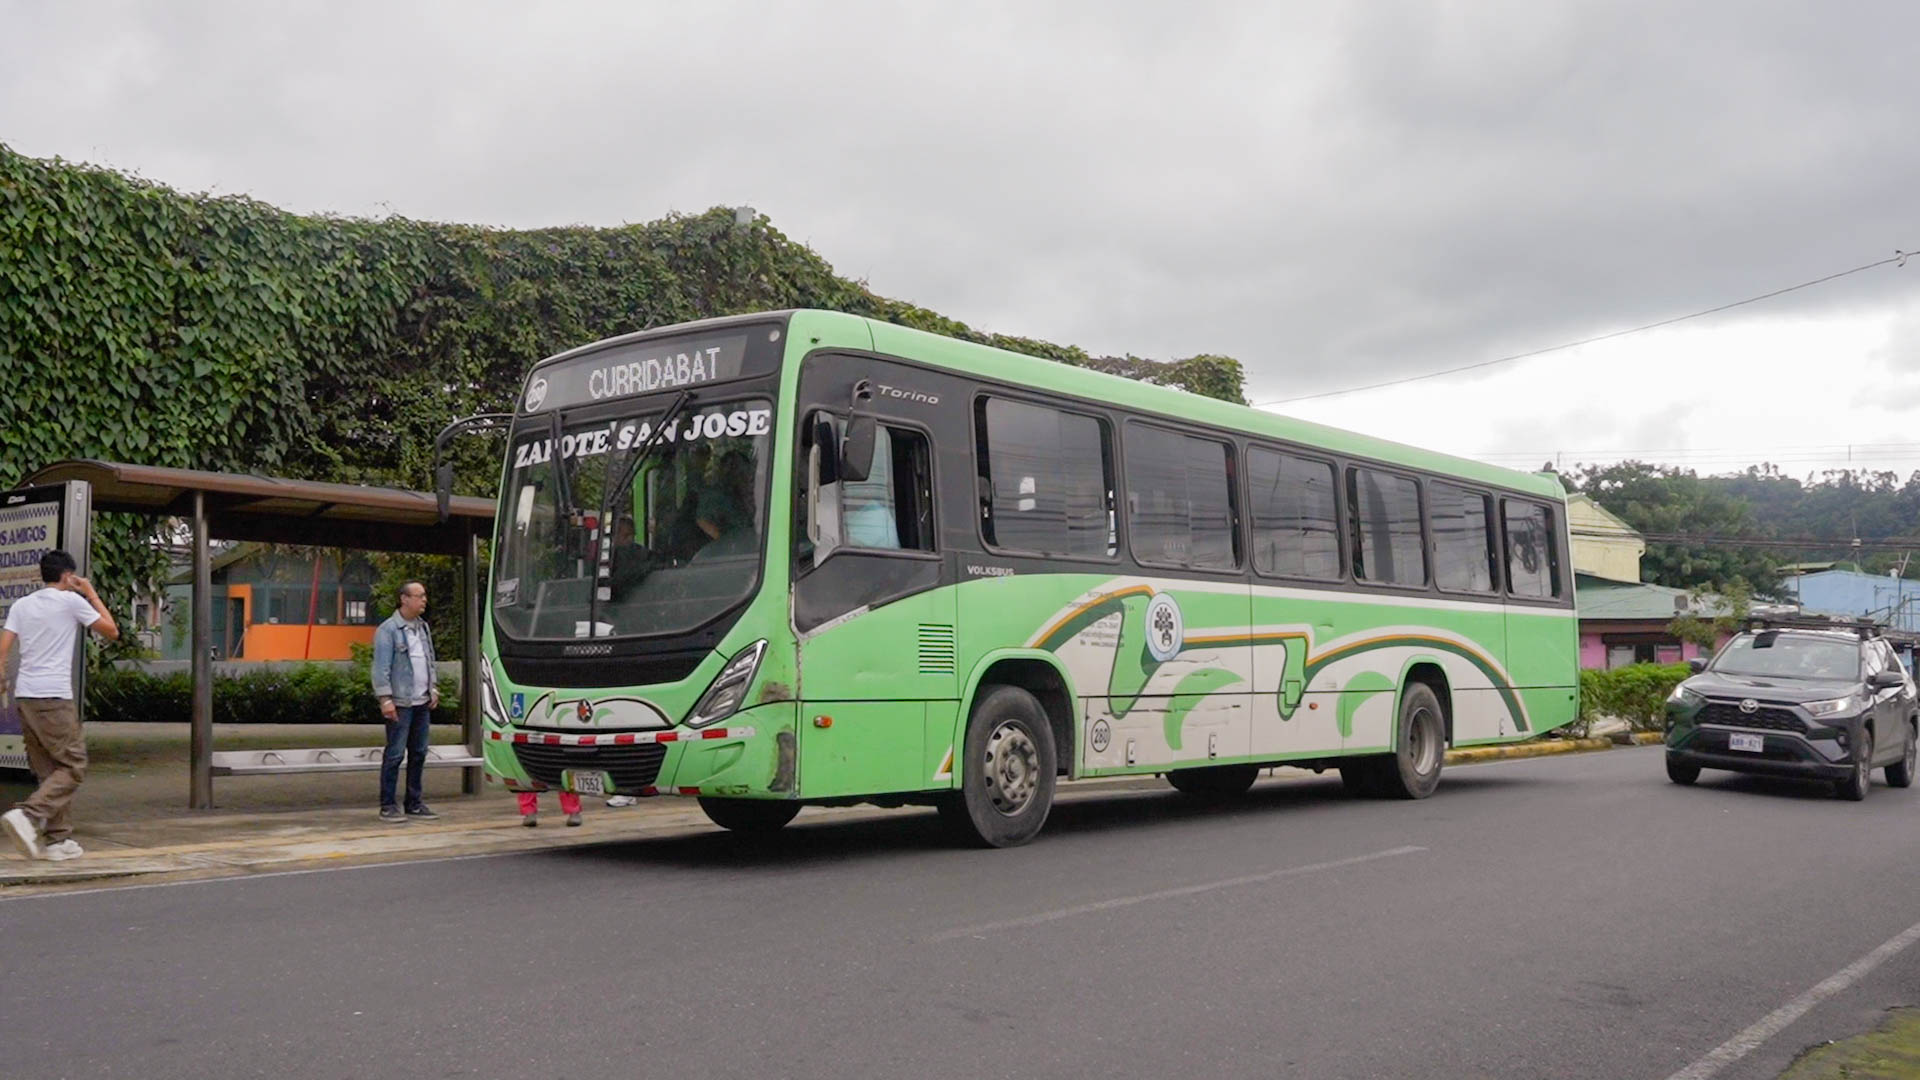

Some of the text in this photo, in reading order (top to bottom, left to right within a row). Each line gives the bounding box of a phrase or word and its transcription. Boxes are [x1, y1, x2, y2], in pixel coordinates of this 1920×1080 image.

[589, 347, 720, 399] CURRIDABAT
[877, 384, 939, 404] Torino
[682, 409, 771, 441] JOSE
[8, 525, 46, 544] AMIGOS
[967, 564, 1015, 576] VOLKSBUS
[576, 777, 600, 791] 17552
